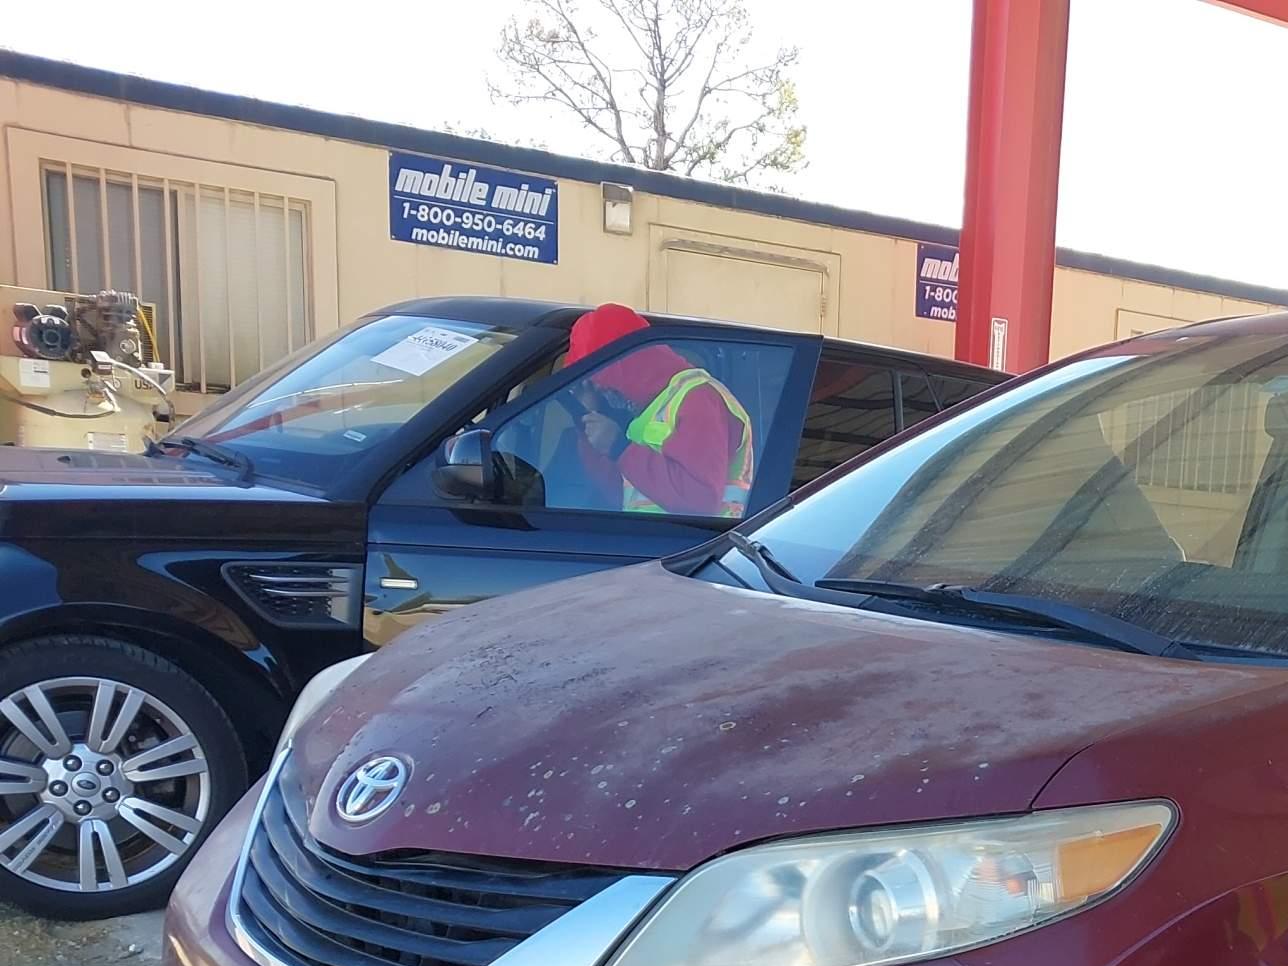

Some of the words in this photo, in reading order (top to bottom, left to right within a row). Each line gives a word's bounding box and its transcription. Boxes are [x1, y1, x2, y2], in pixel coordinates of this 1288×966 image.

[395, 164, 489, 206] mobile
[491, 184, 553, 217] mini
[402, 202, 546, 241] 1-800-950-6464
[411, 227, 540, 259] mobilemini.com
